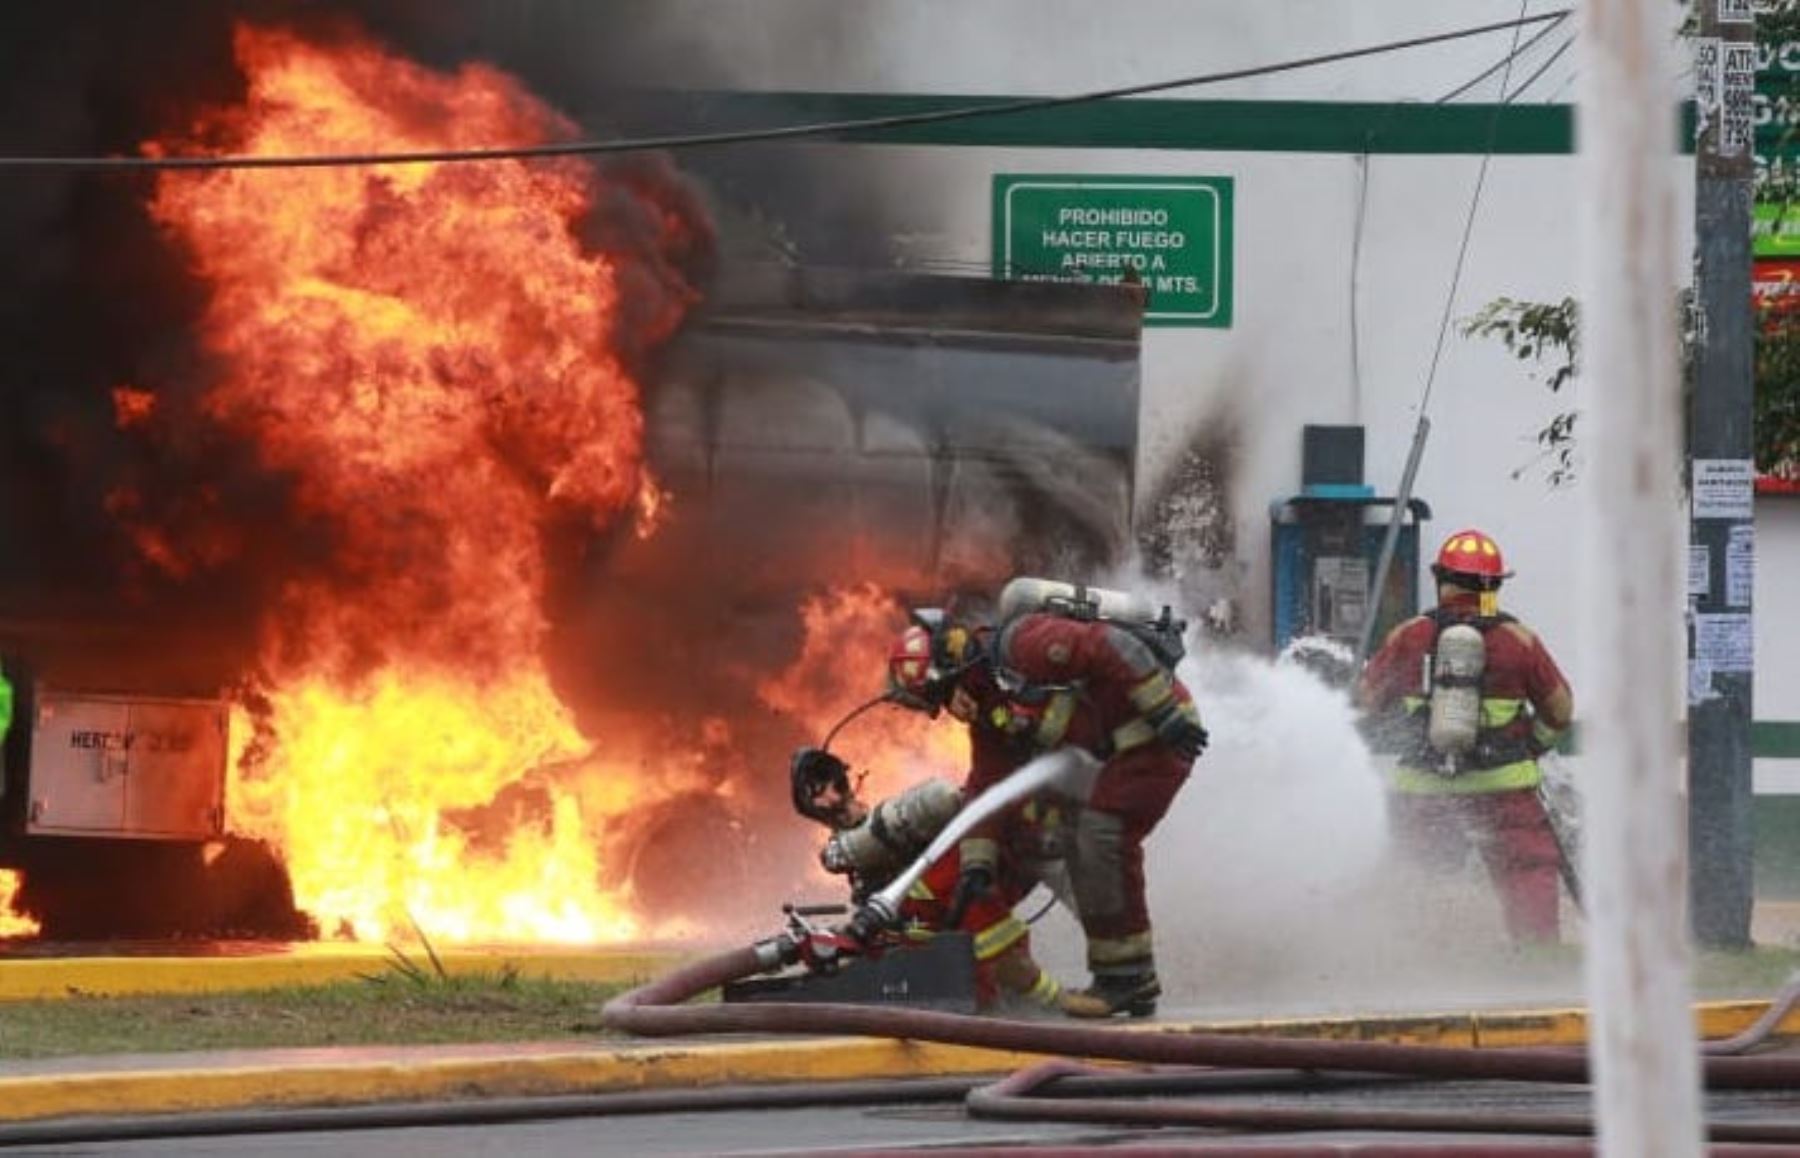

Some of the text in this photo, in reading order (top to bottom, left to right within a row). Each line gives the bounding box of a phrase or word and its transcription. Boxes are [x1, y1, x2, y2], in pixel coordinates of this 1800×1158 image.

[1059, 208, 1168, 226] PROHIBIDO
[1042, 231, 1185, 248] HACER FUEGO
[1062, 253, 1166, 270] ABIERTO A
